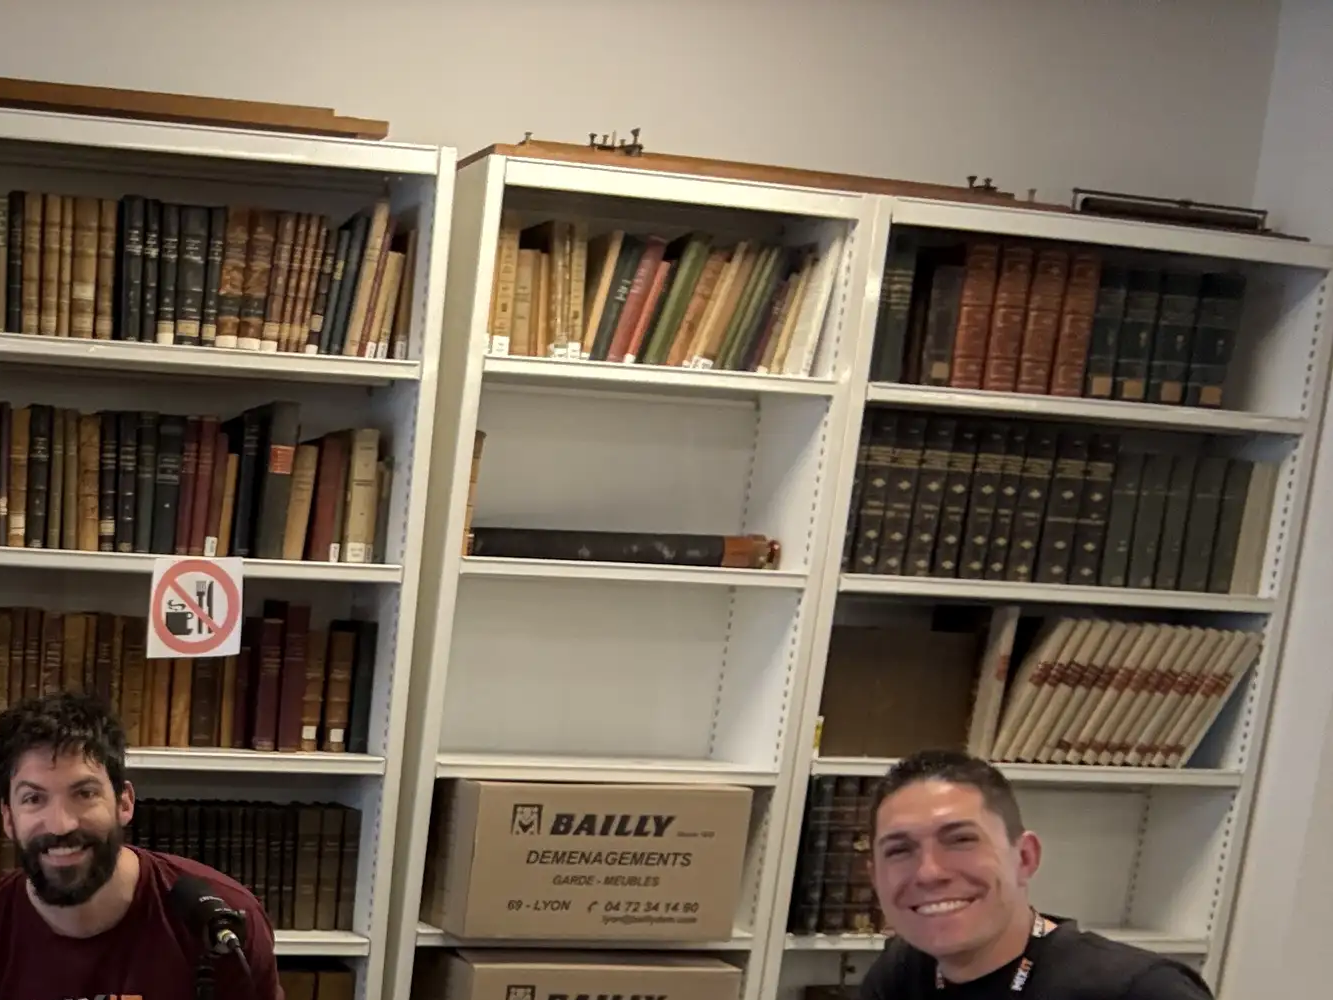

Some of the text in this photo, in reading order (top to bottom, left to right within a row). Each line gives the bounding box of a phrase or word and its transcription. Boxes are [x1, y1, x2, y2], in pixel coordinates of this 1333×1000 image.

[550, 813, 677, 837] BAILLY
[526, 850, 693, 867] DEMENAGEMENTS
[553, 875, 594, 886] GARDE
[604, 876, 660, 887] MEUBLES
[507, 900, 523, 911] 69
[533, 900, 571, 911] LYON
[604, 901, 620, 912] 04
[625, 901, 640, 912] 72
[644, 902, 659, 912] 34
[664, 902, 679, 913] 14
